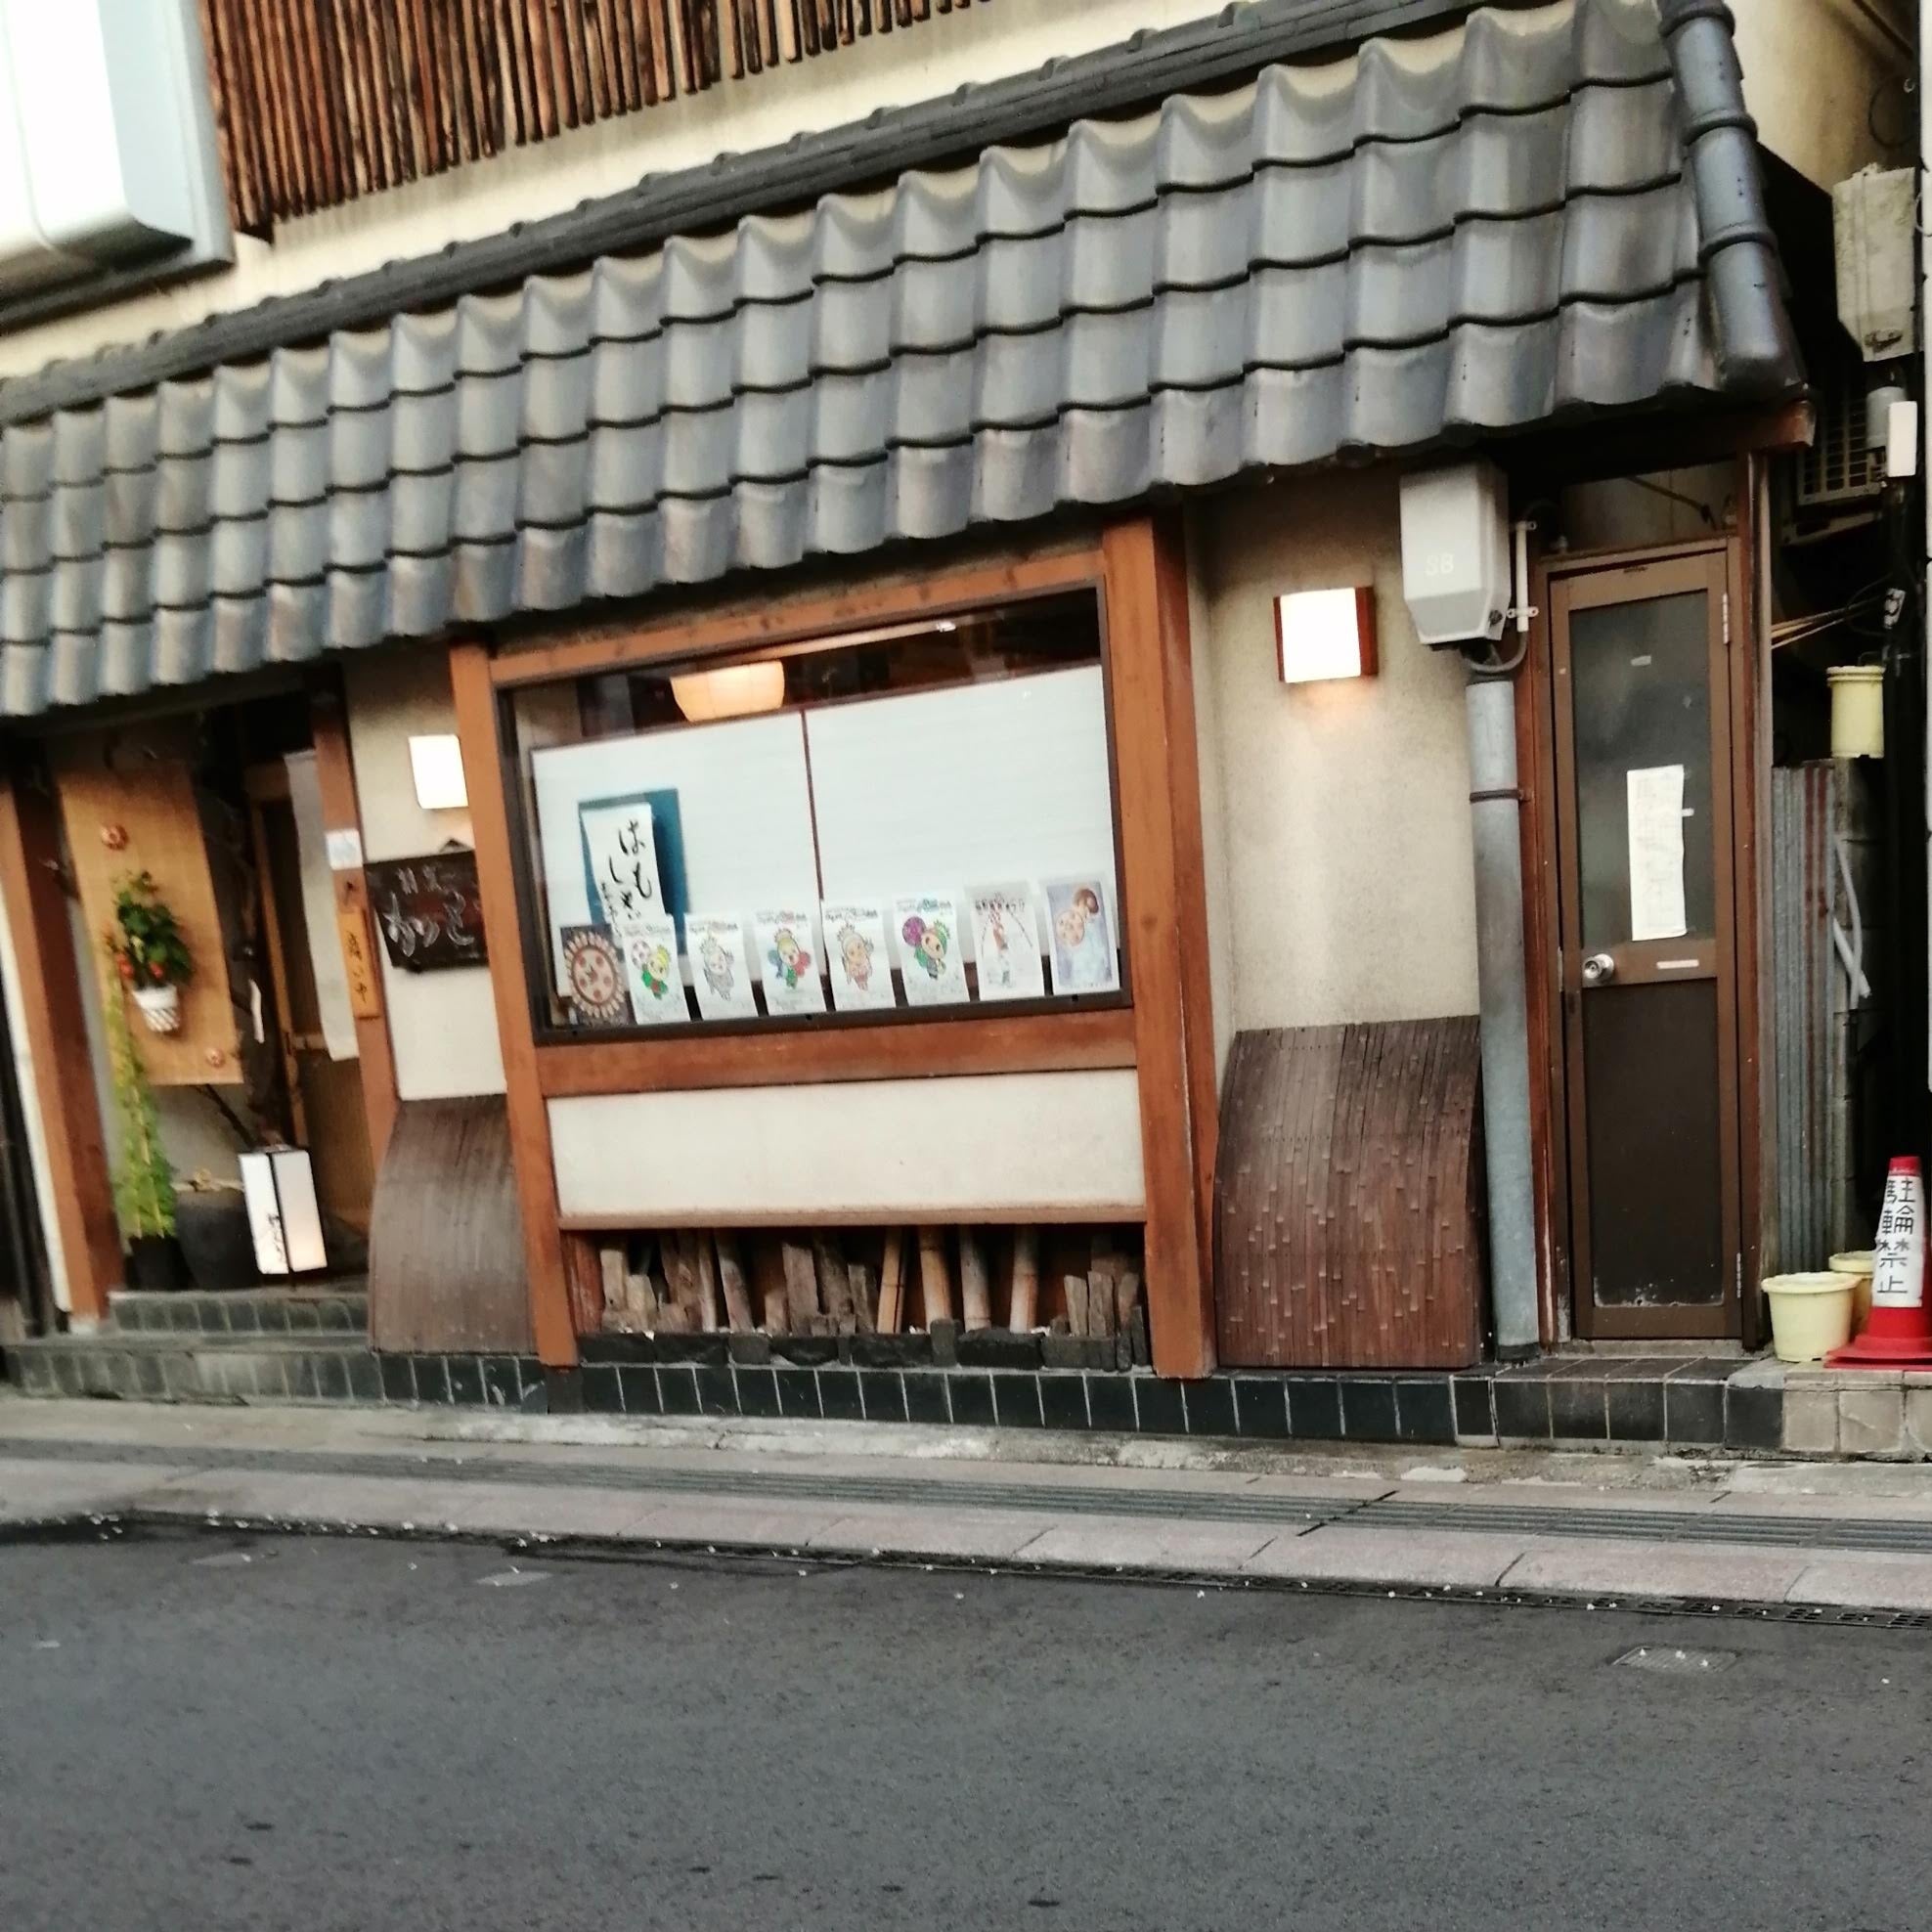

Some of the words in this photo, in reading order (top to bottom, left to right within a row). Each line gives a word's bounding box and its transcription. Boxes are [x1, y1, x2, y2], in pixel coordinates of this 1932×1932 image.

[618, 818, 652, 900] はも
[1876, 1177, 1916, 1295] 駐輪禁止
